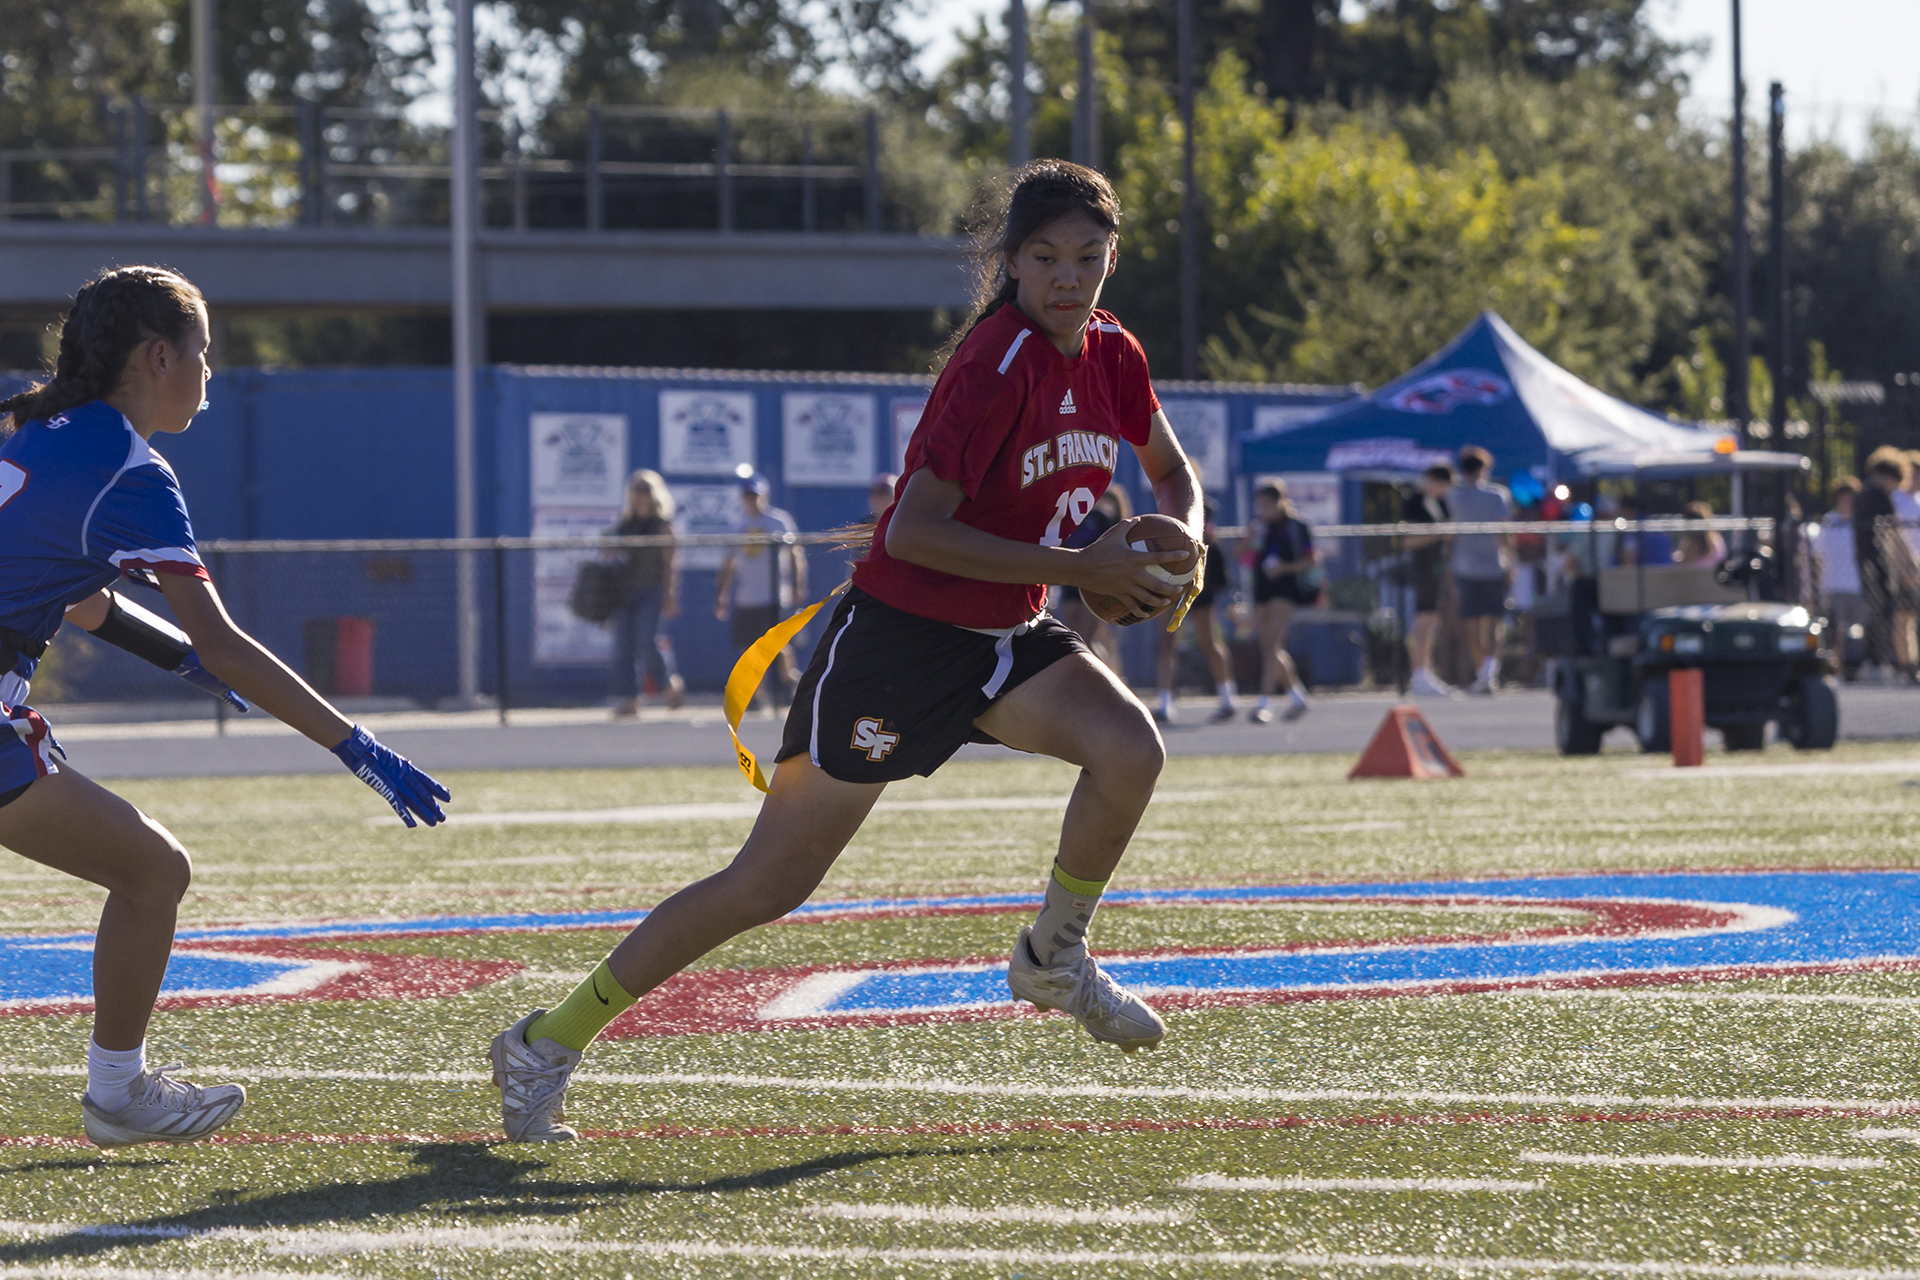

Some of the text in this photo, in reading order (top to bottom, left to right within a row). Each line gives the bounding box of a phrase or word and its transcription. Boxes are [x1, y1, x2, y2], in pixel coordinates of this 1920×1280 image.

[1059, 405, 1076, 414] adidas
[1021, 439, 1056, 488] ST.
[851, 717, 900, 762] SF
[356, 763, 395, 802] NXTRND
